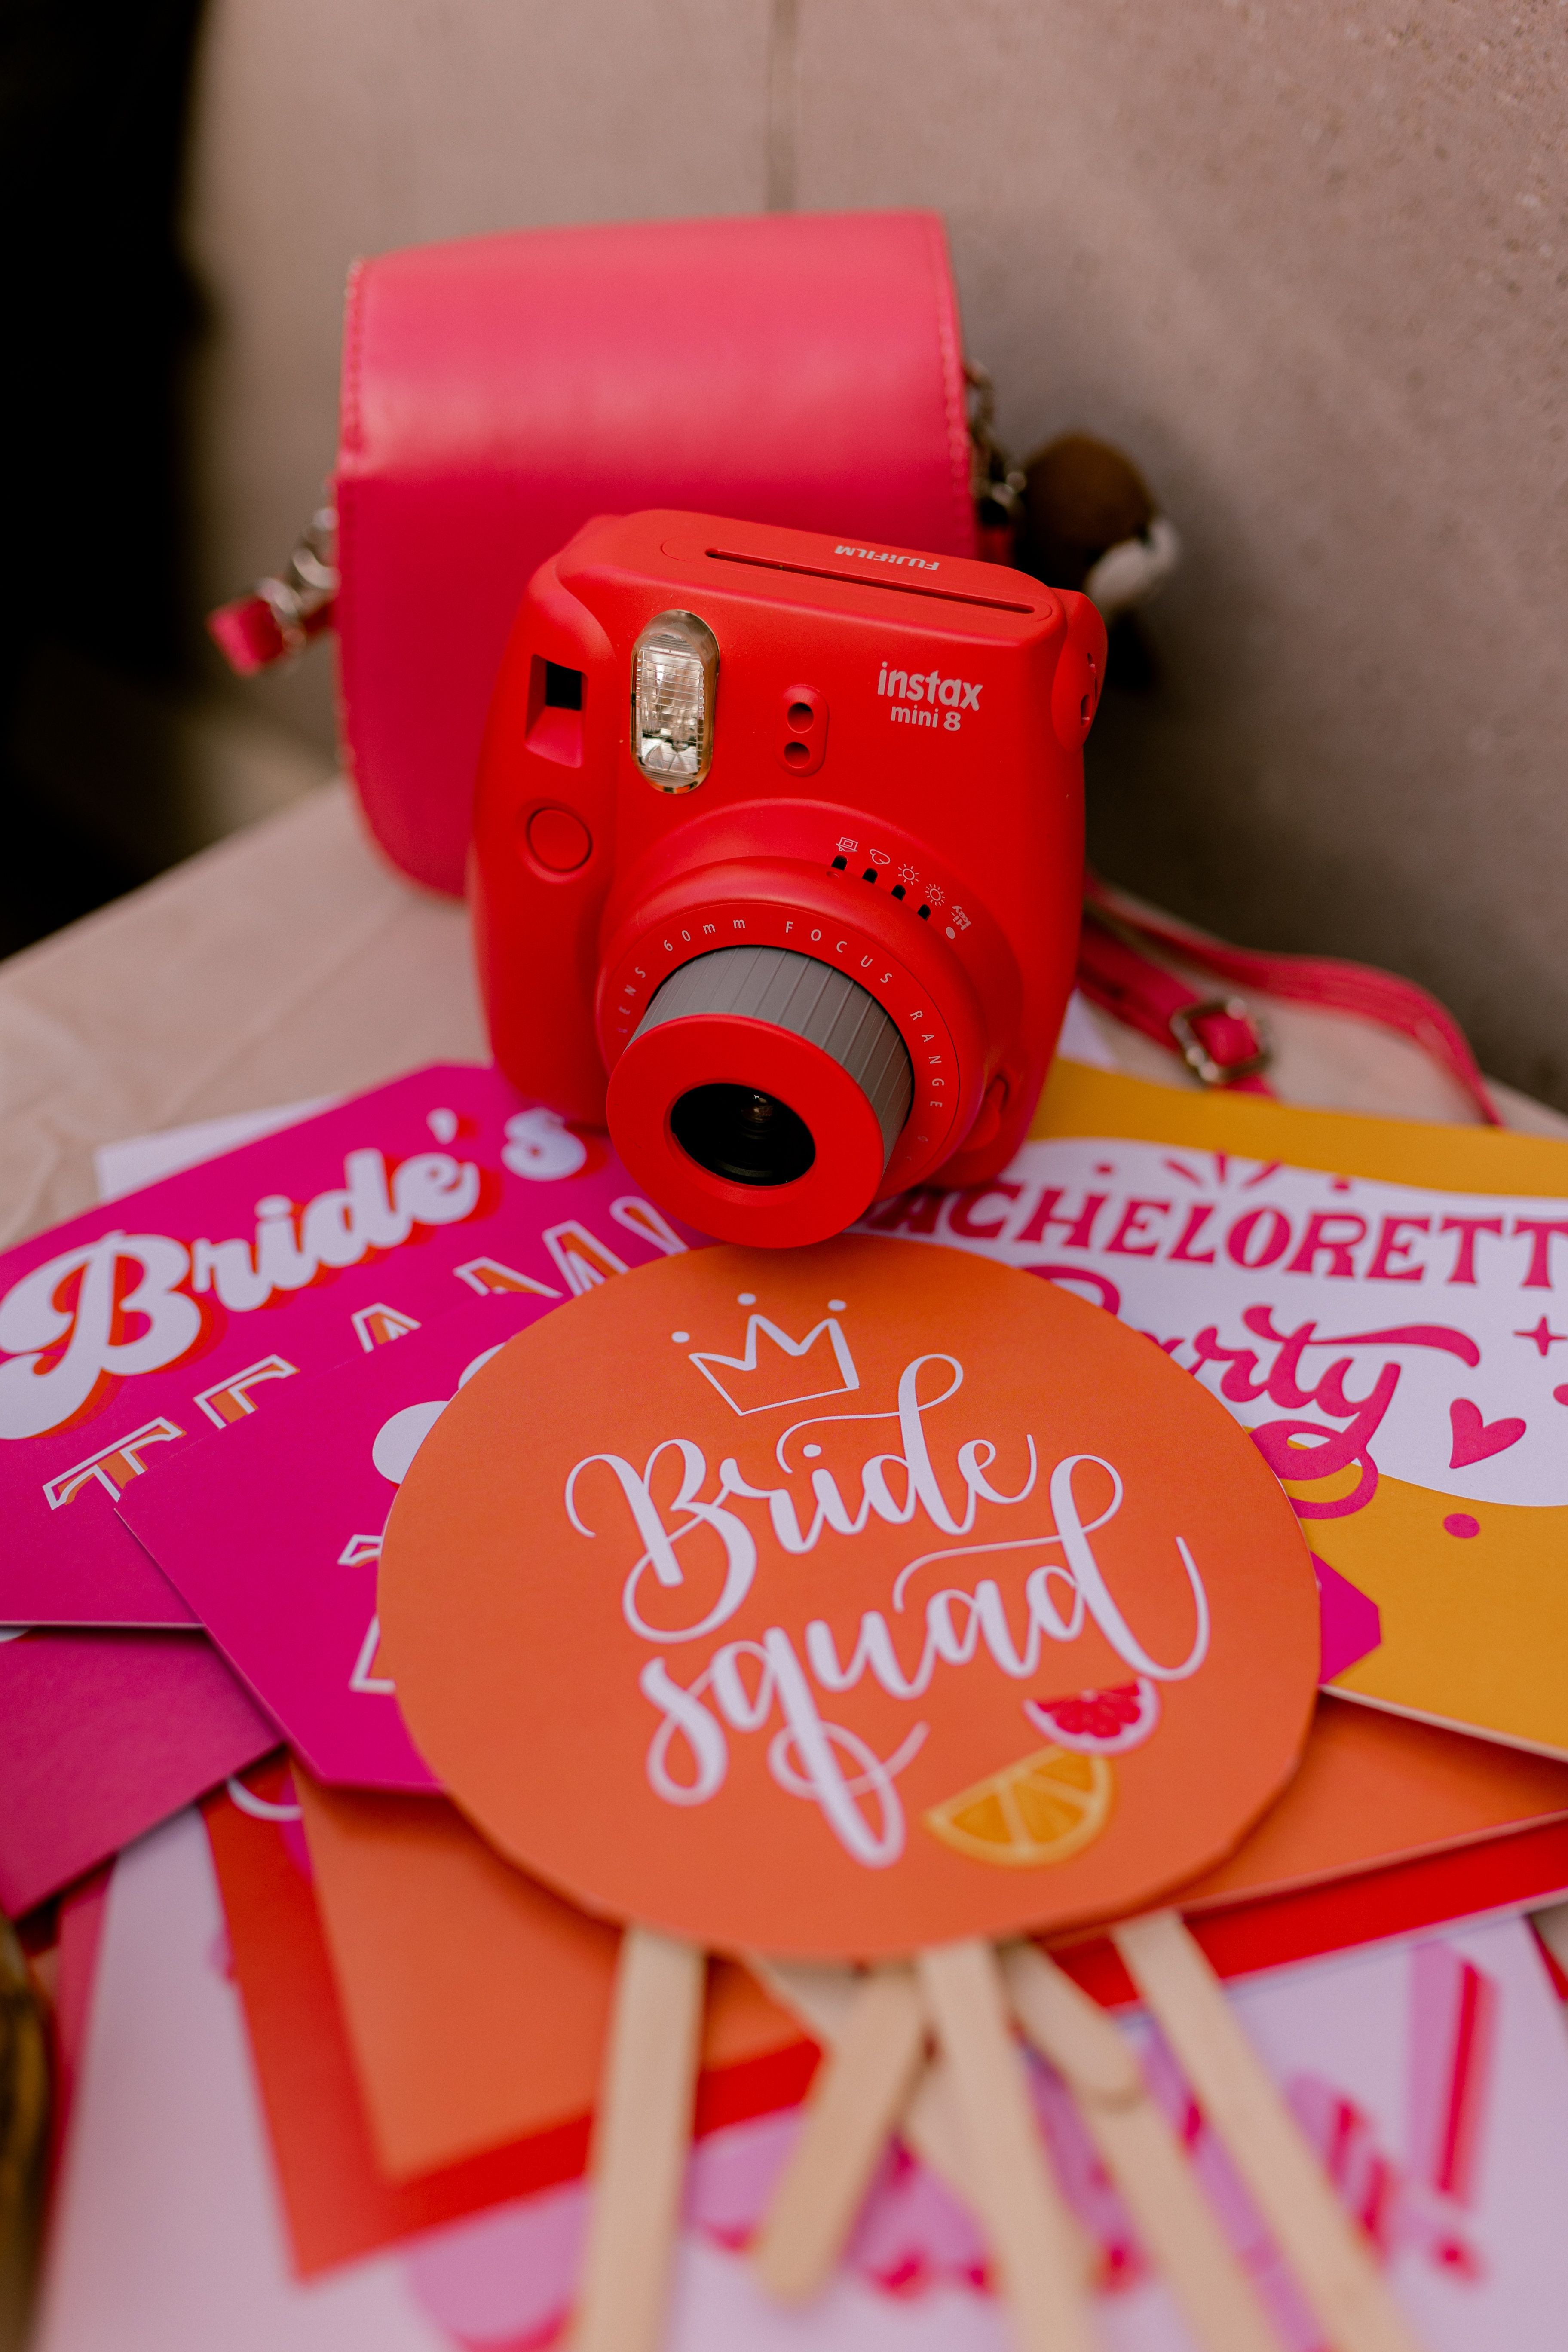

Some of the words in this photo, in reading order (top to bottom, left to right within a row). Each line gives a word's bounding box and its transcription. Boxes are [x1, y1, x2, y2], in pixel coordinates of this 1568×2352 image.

[834, 545, 940, 570] FUJIFILM
[877, 661, 983, 711] instax
[891, 704, 938, 728] mini
[943, 711, 961, 731] 8
[785, 920, 893, 984] FOCUS
[910, 1009, 945, 1108] RANGE
[0, 1107, 588, 1441] Bride's
[853, 1179, 1568, 1290] ACHELORETT
[564, 1353, 1035, 1644] Bride
[639, 1454, 1210, 1868] squad
